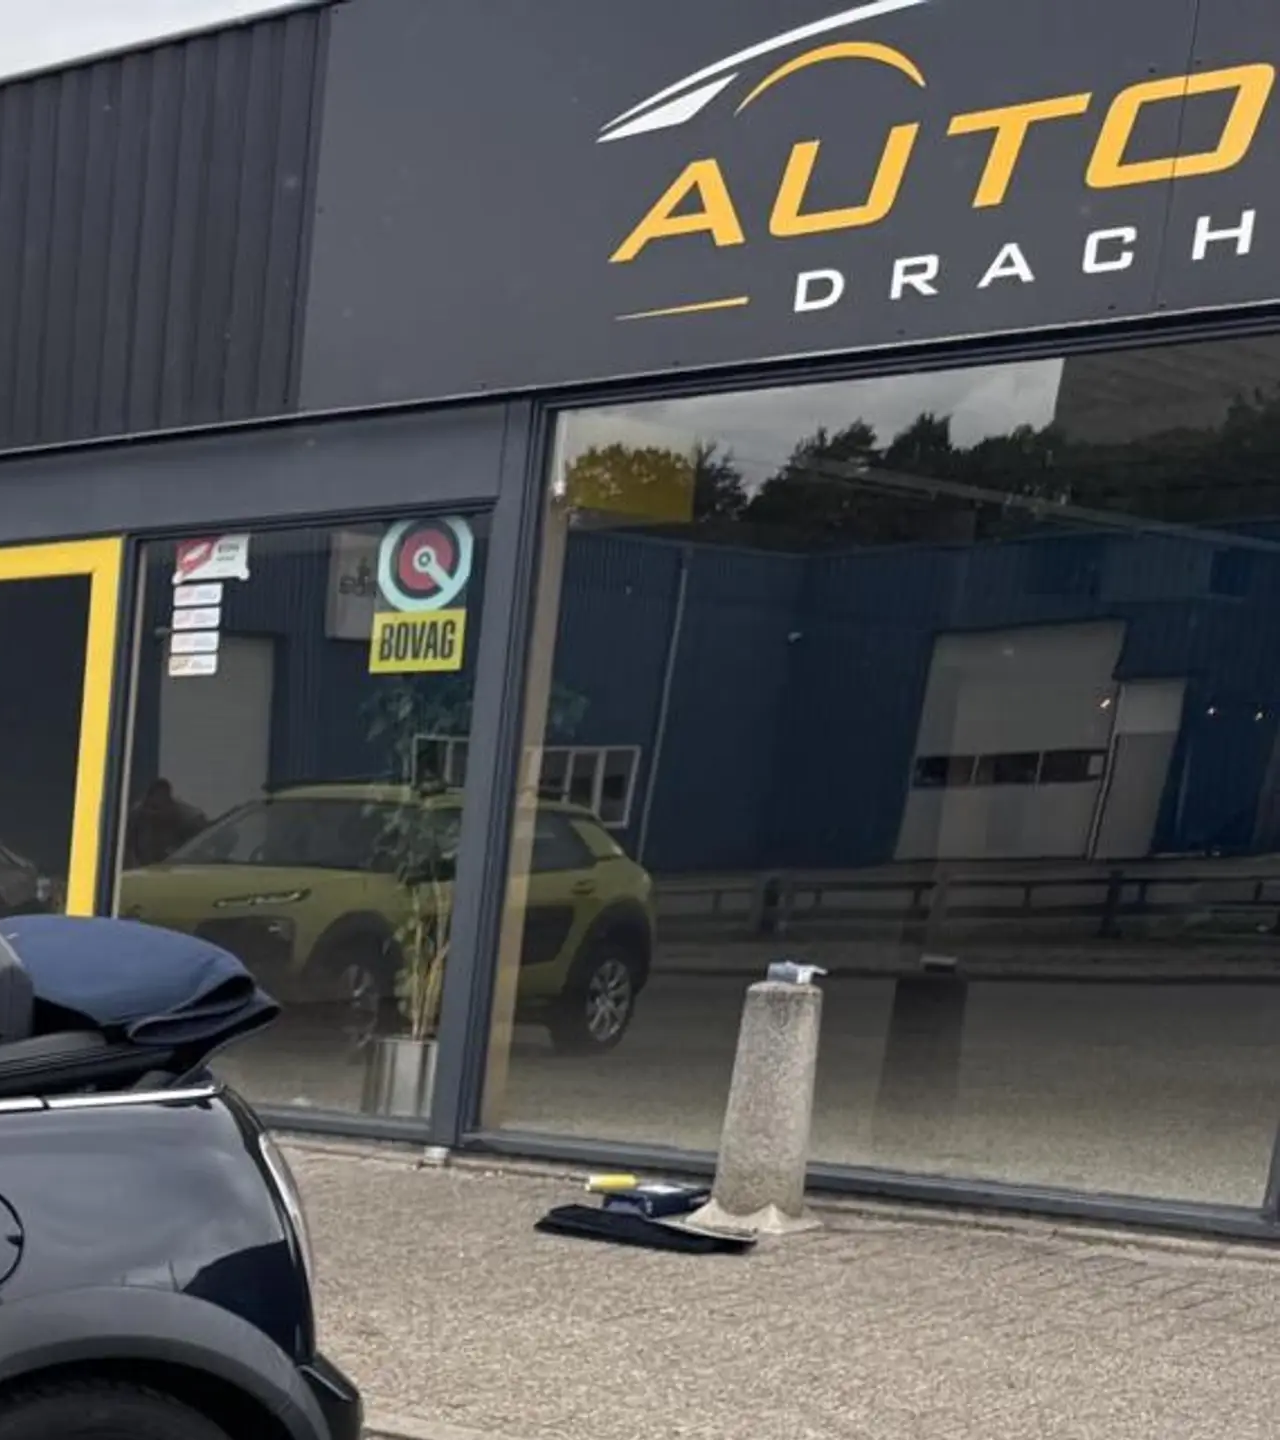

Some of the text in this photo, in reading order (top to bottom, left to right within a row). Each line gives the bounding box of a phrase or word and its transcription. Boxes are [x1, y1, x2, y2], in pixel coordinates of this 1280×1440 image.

[608, 63, 1277, 263] AUTO
[792, 209, 1257, 313] DRACH
[379, 619, 457, 662] BOVAG
